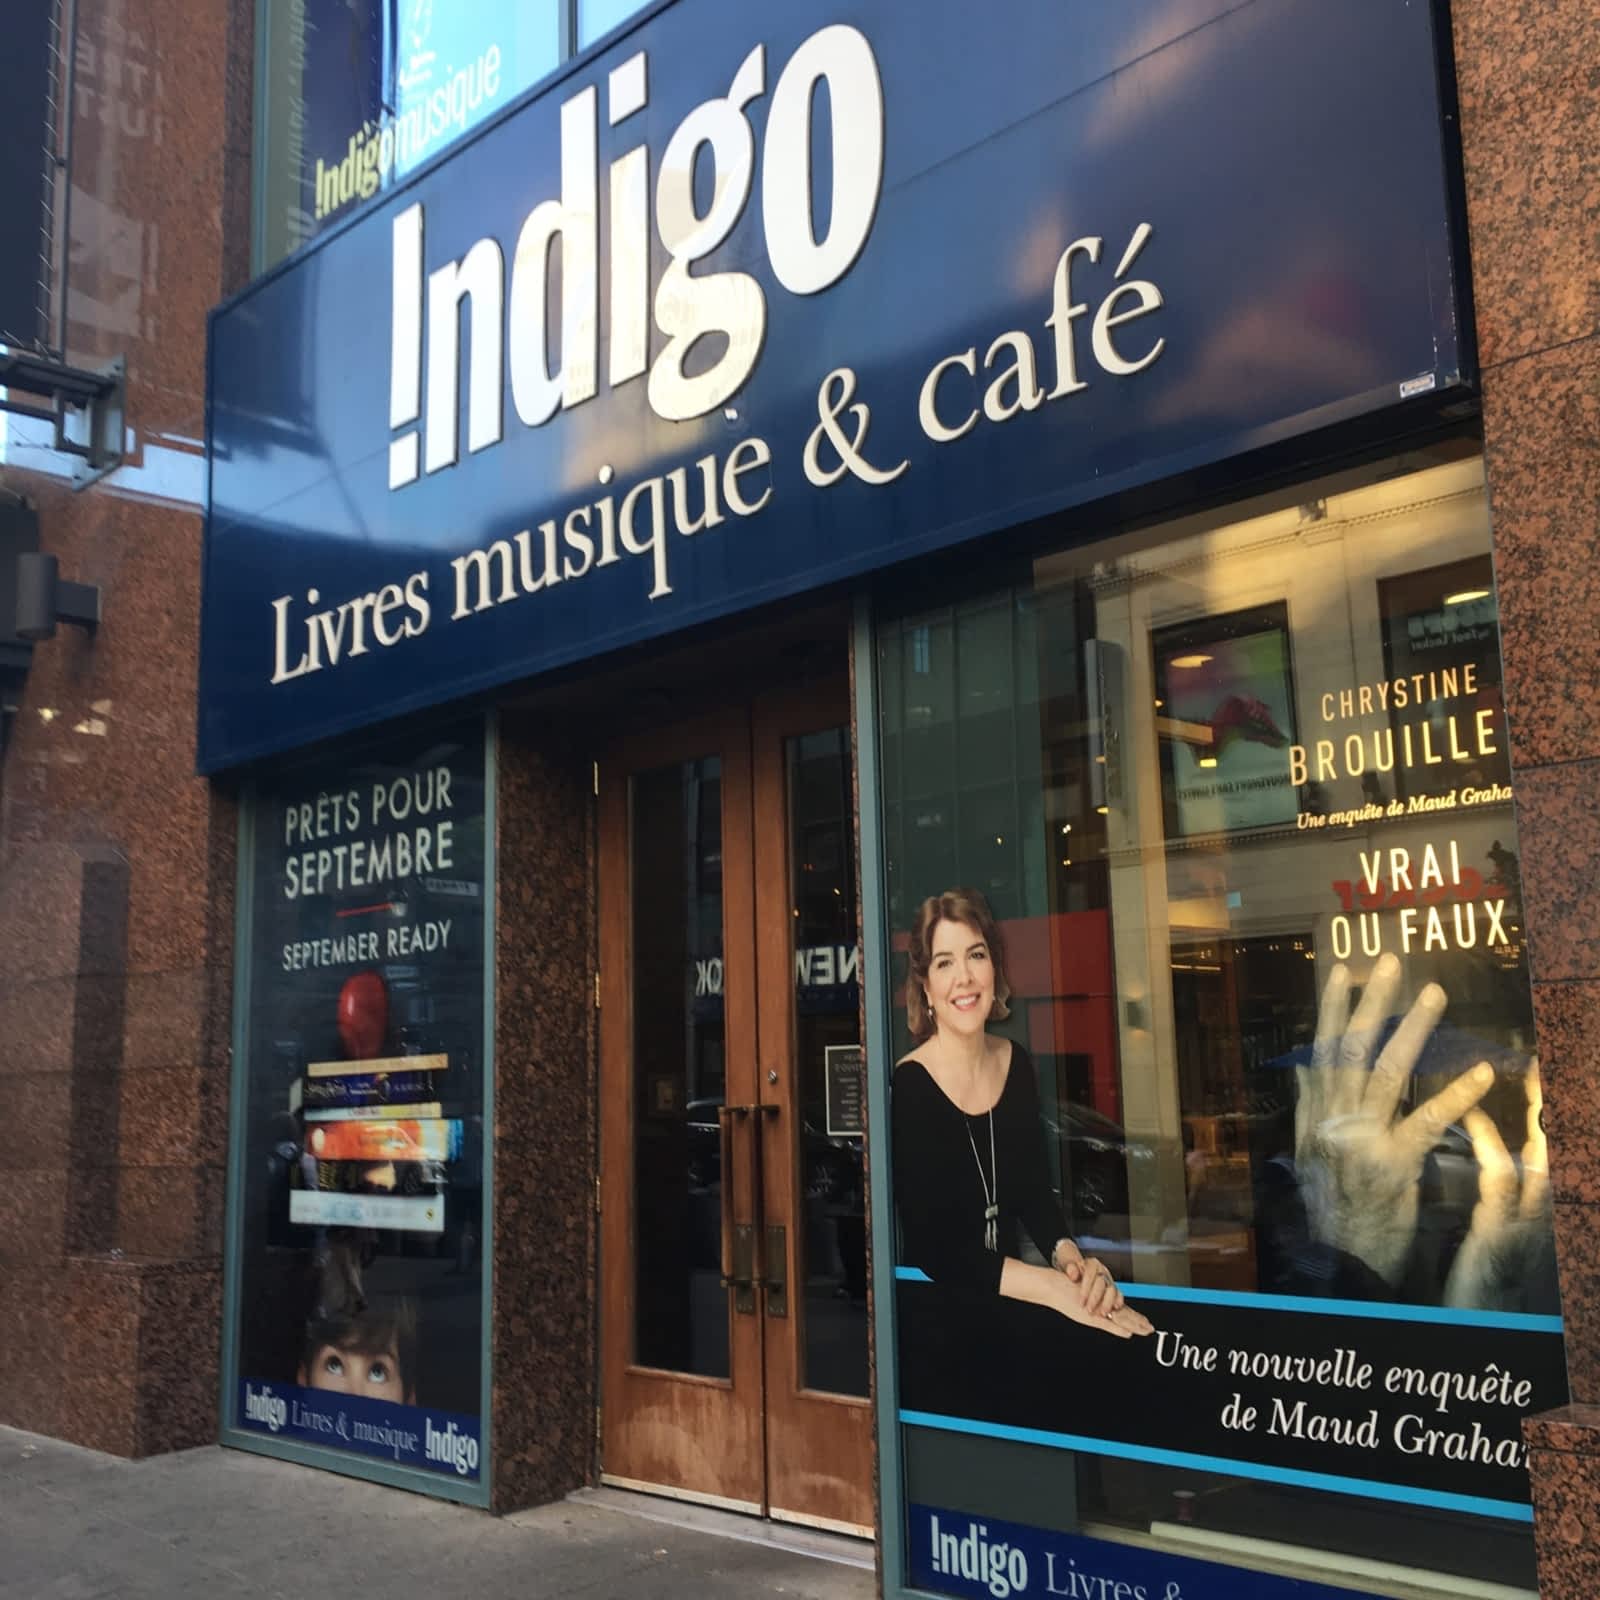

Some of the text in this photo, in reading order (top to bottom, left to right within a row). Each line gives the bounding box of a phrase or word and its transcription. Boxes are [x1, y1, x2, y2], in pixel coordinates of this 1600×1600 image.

[394, 43, 501, 164] musique
[389, 24, 885, 490] Indigo
[271, 222, 1165, 684] Livres musique & café
[1321, 663, 1478, 722] CHRYSTINE
[1289, 709, 1497, 787] BROUILLE
[285, 766, 453, 846] PRÊTS POUR
[1297, 813, 1325, 830] Une
[1328, 801, 1383, 829] enquête
[1386, 800, 1404, 818] de
[1408, 789, 1457, 813] Maud
[284, 821, 454, 899] SEPTEMBRE
[1359, 840, 1460, 895] VRAI
[282, 919, 452, 971] SEPTEMBER READY
[1331, 899, 1509, 961] OU FAUX
[1154, 1330, 1533, 1413] Une nouvelle enquête
[292, 1400, 333, 1433] Livres
[335, 1411, 351, 1441] &
[353, 1419, 418, 1460] musique
[1221, 1393, 1530, 1469] de Maud Graha
[930, 1514, 1184, 1600] Indigo Livres &
